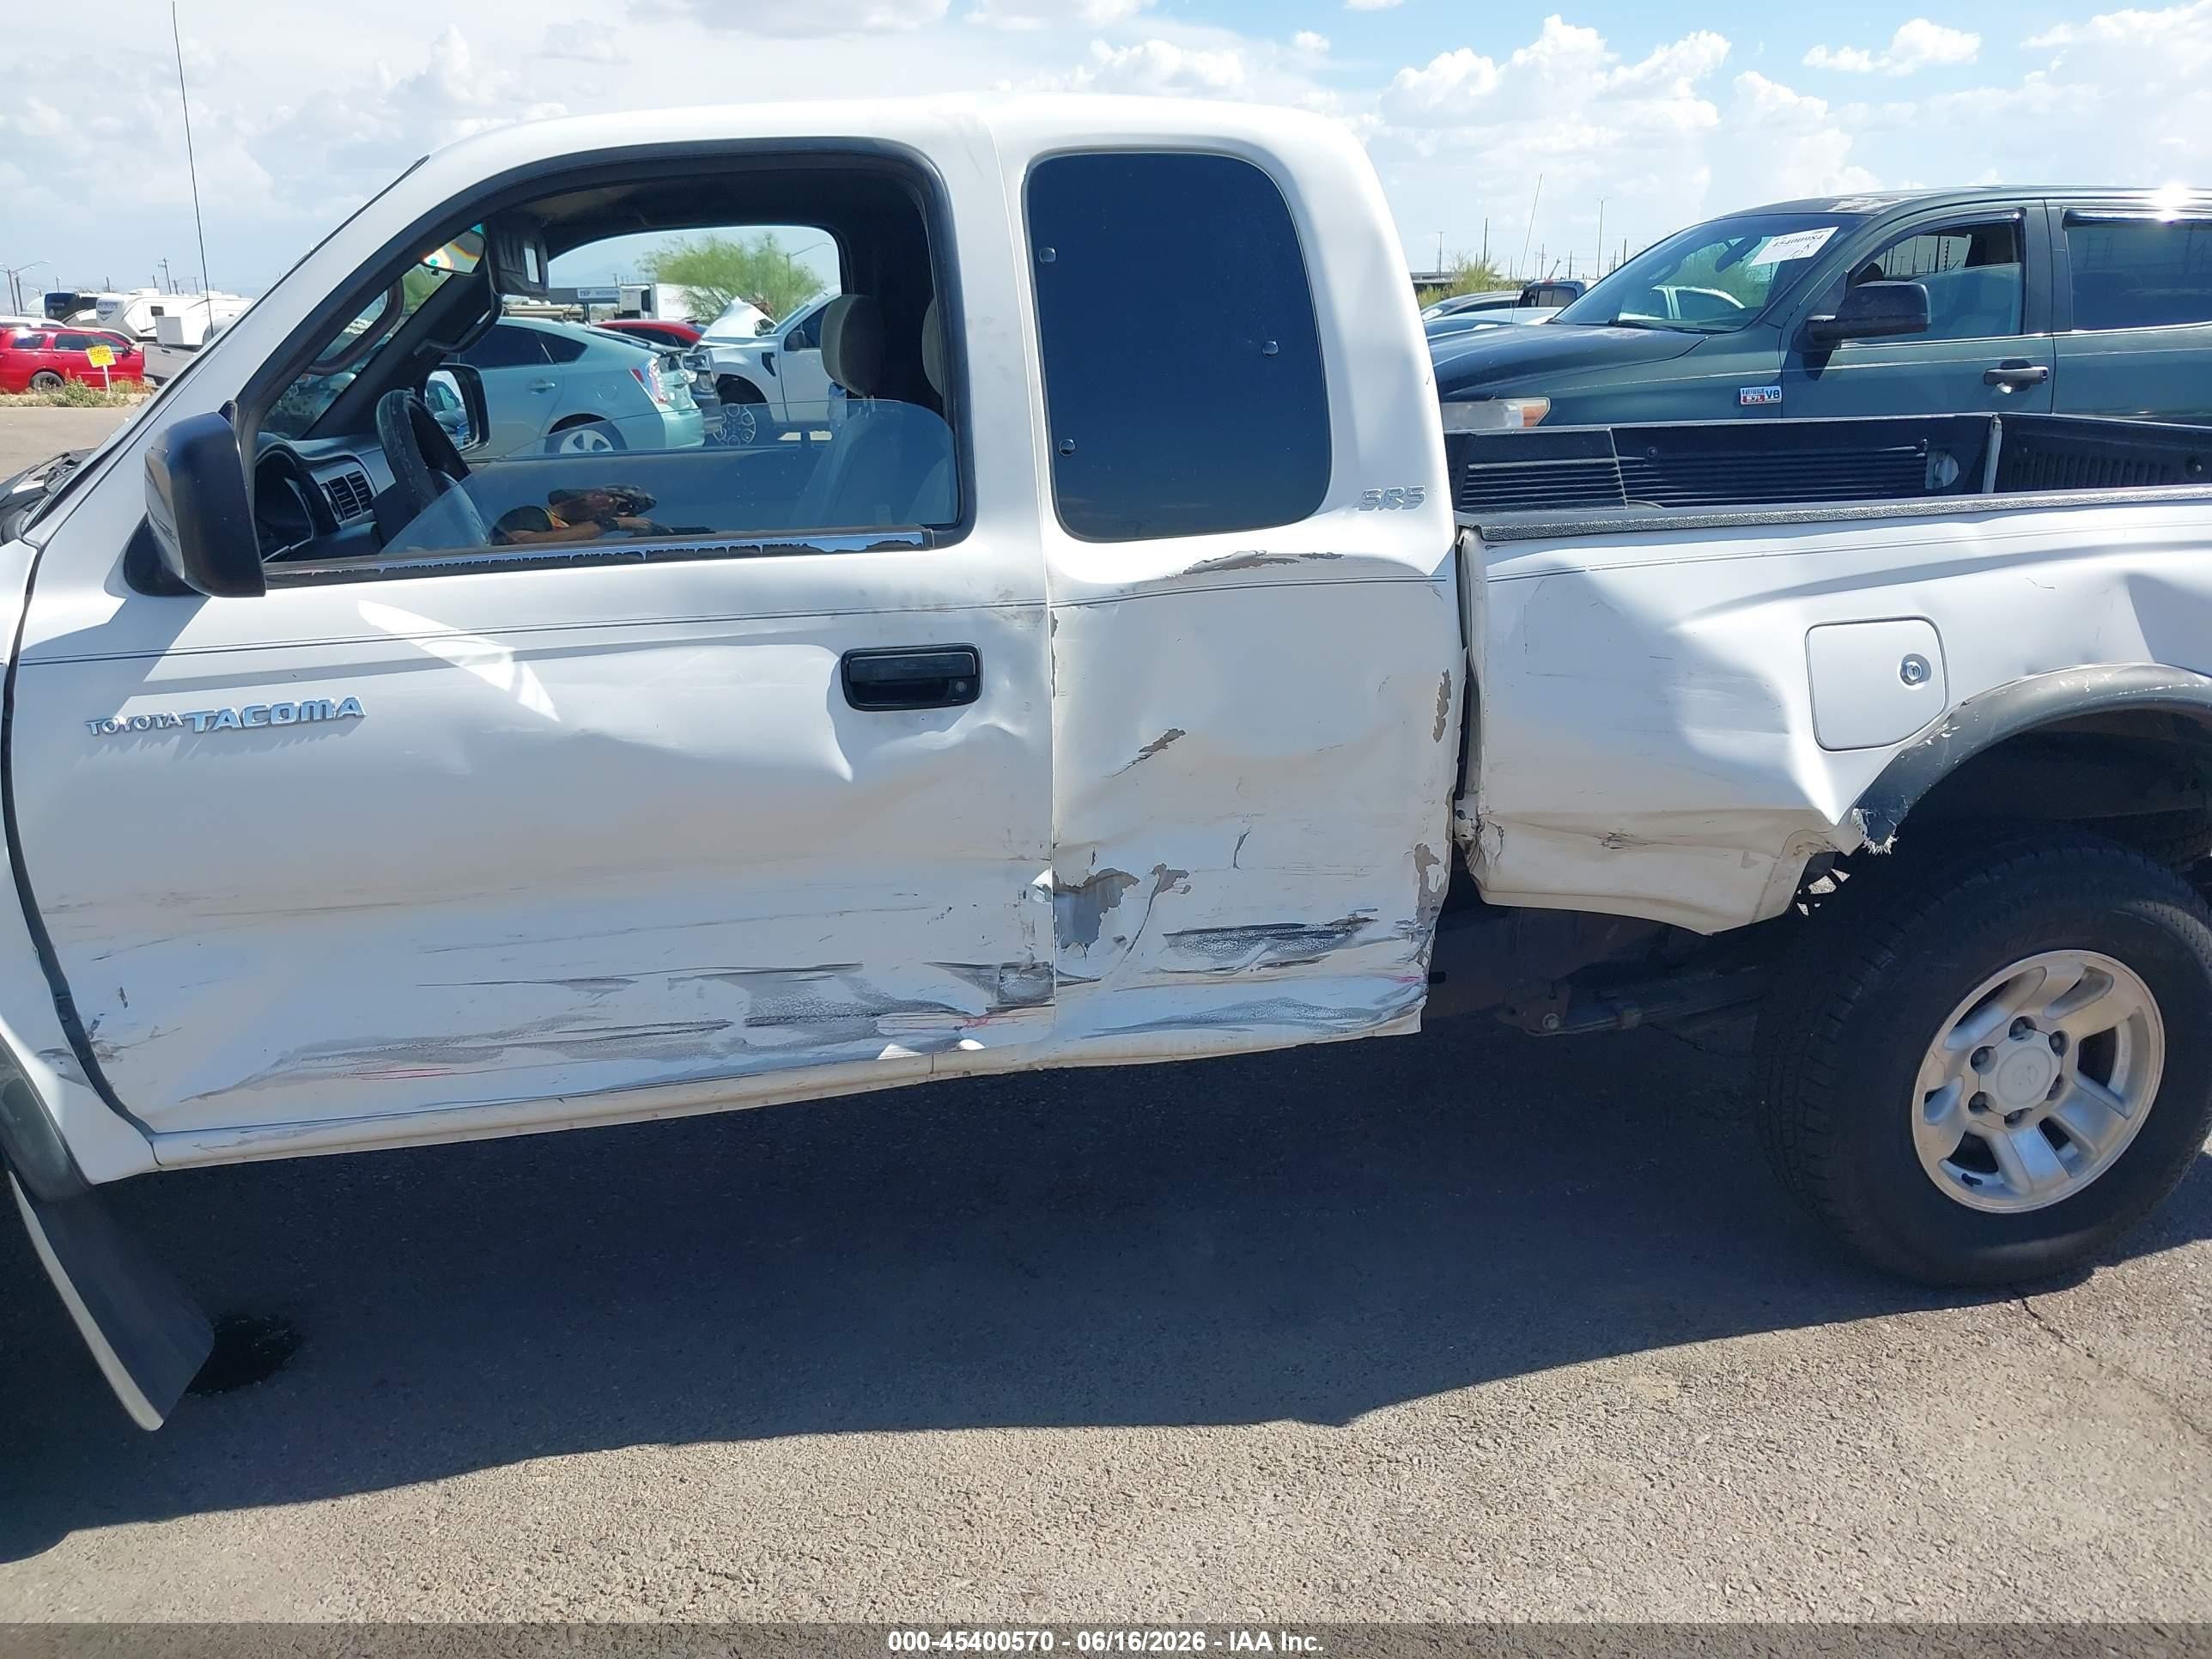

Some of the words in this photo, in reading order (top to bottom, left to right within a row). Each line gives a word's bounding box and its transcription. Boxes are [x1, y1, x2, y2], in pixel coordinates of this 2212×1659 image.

[1765, 389, 1780, 399] V8
[1361, 485, 1425, 507] SR5
[86, 711, 185, 736] TOYOTA
[185, 695, 368, 733] TACOMA
